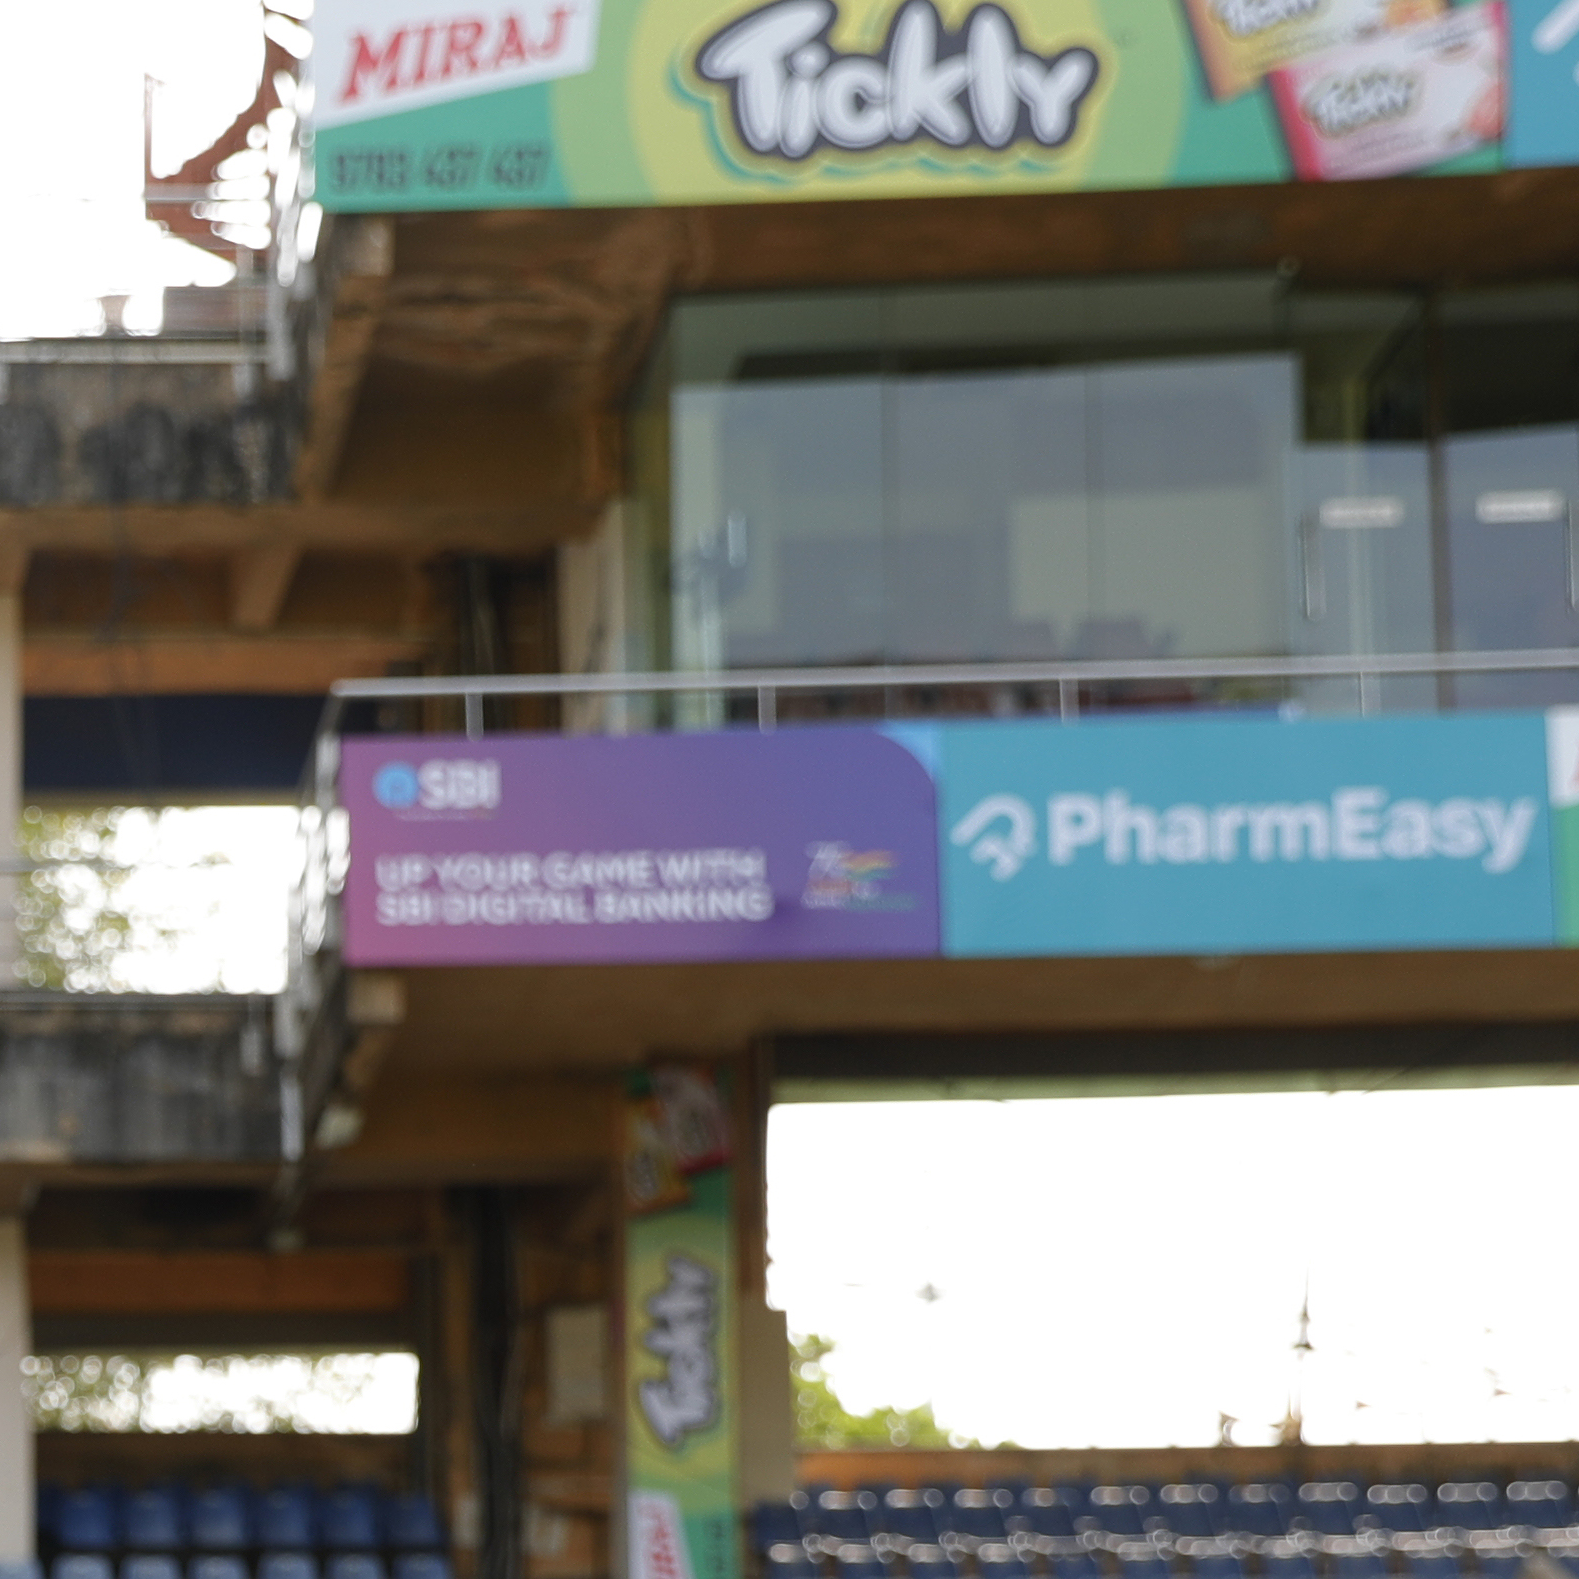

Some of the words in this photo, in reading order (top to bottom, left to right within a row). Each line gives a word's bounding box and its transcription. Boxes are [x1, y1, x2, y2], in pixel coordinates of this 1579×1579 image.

[336, 2, 579, 106] MIRAJ
[698, 0, 1099, 158] Tickly
[417, 757, 502, 810] SBI
[1042, 783, 1541, 876] PharmEasy
[373, 852, 434, 892] UP
[431, 851, 541, 892] YOUR
[542, 850, 652, 890] GAME
[655, 847, 768, 887] WITH
[375, 889, 436, 927] SBI
[440, 887, 591, 926] DIGITAL
[591, 883, 776, 924] BANKING
